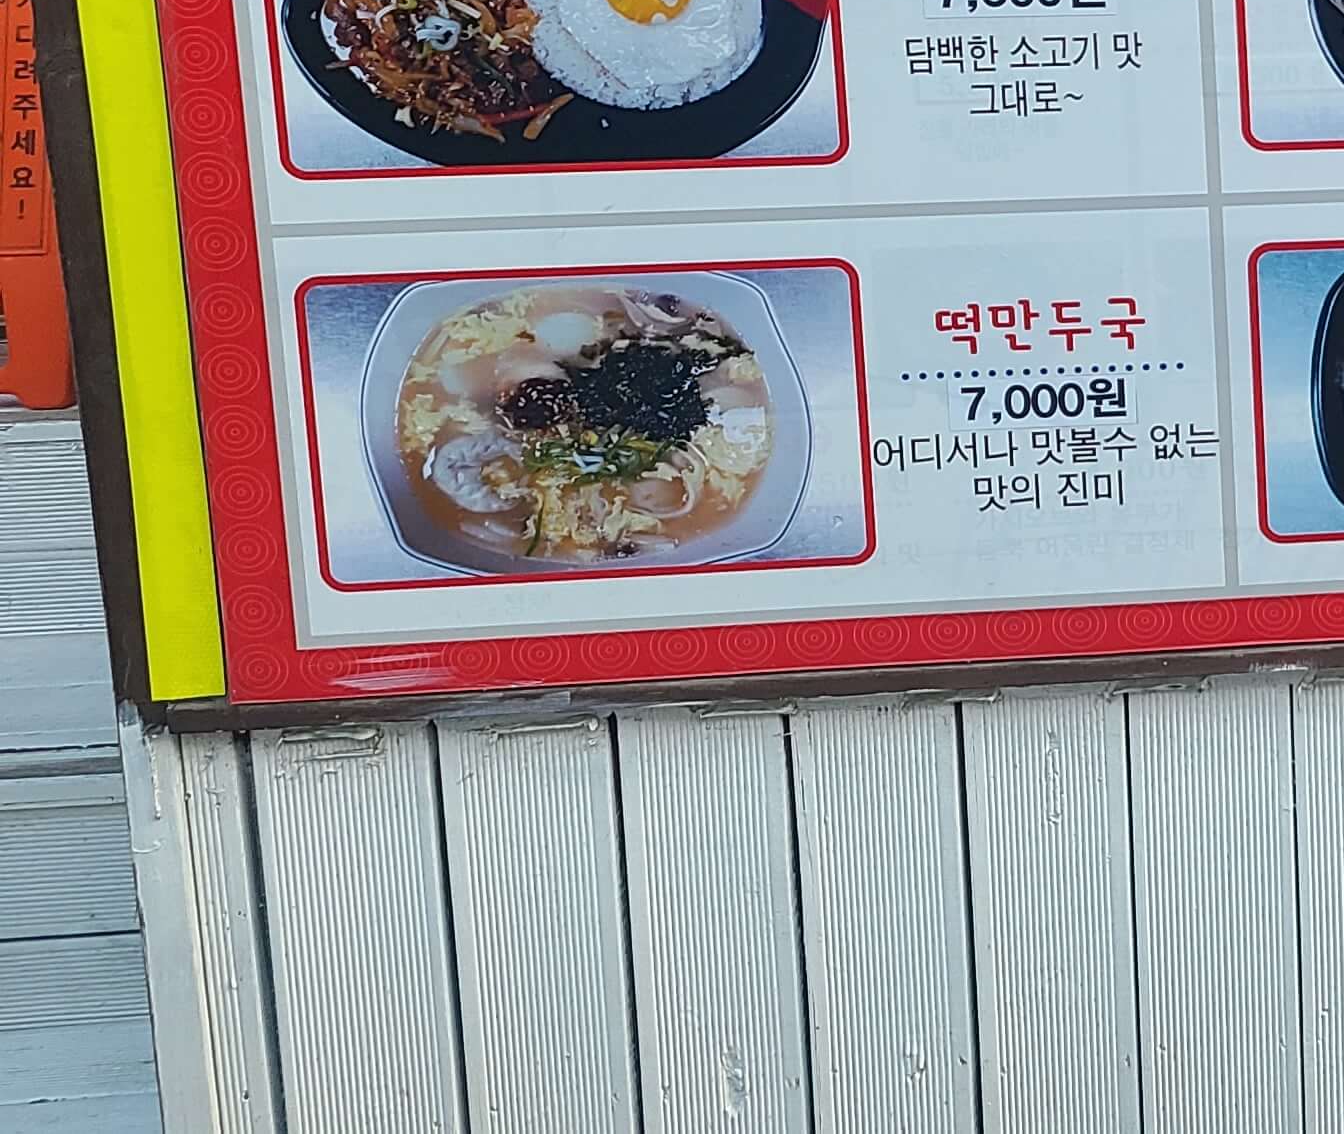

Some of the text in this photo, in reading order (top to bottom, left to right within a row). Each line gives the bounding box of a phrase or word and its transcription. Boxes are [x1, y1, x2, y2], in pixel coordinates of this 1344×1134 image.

[904, 31, 1144, 75] 담백한 소고기 맛
[934, 296, 1147, 356] 떡만두국
[959, 377, 1128, 425] 7,000원
[872, 422, 1221, 473] 어디서나 맛볼수 없는
[972, 469, 1126, 513] 맛의 진미
